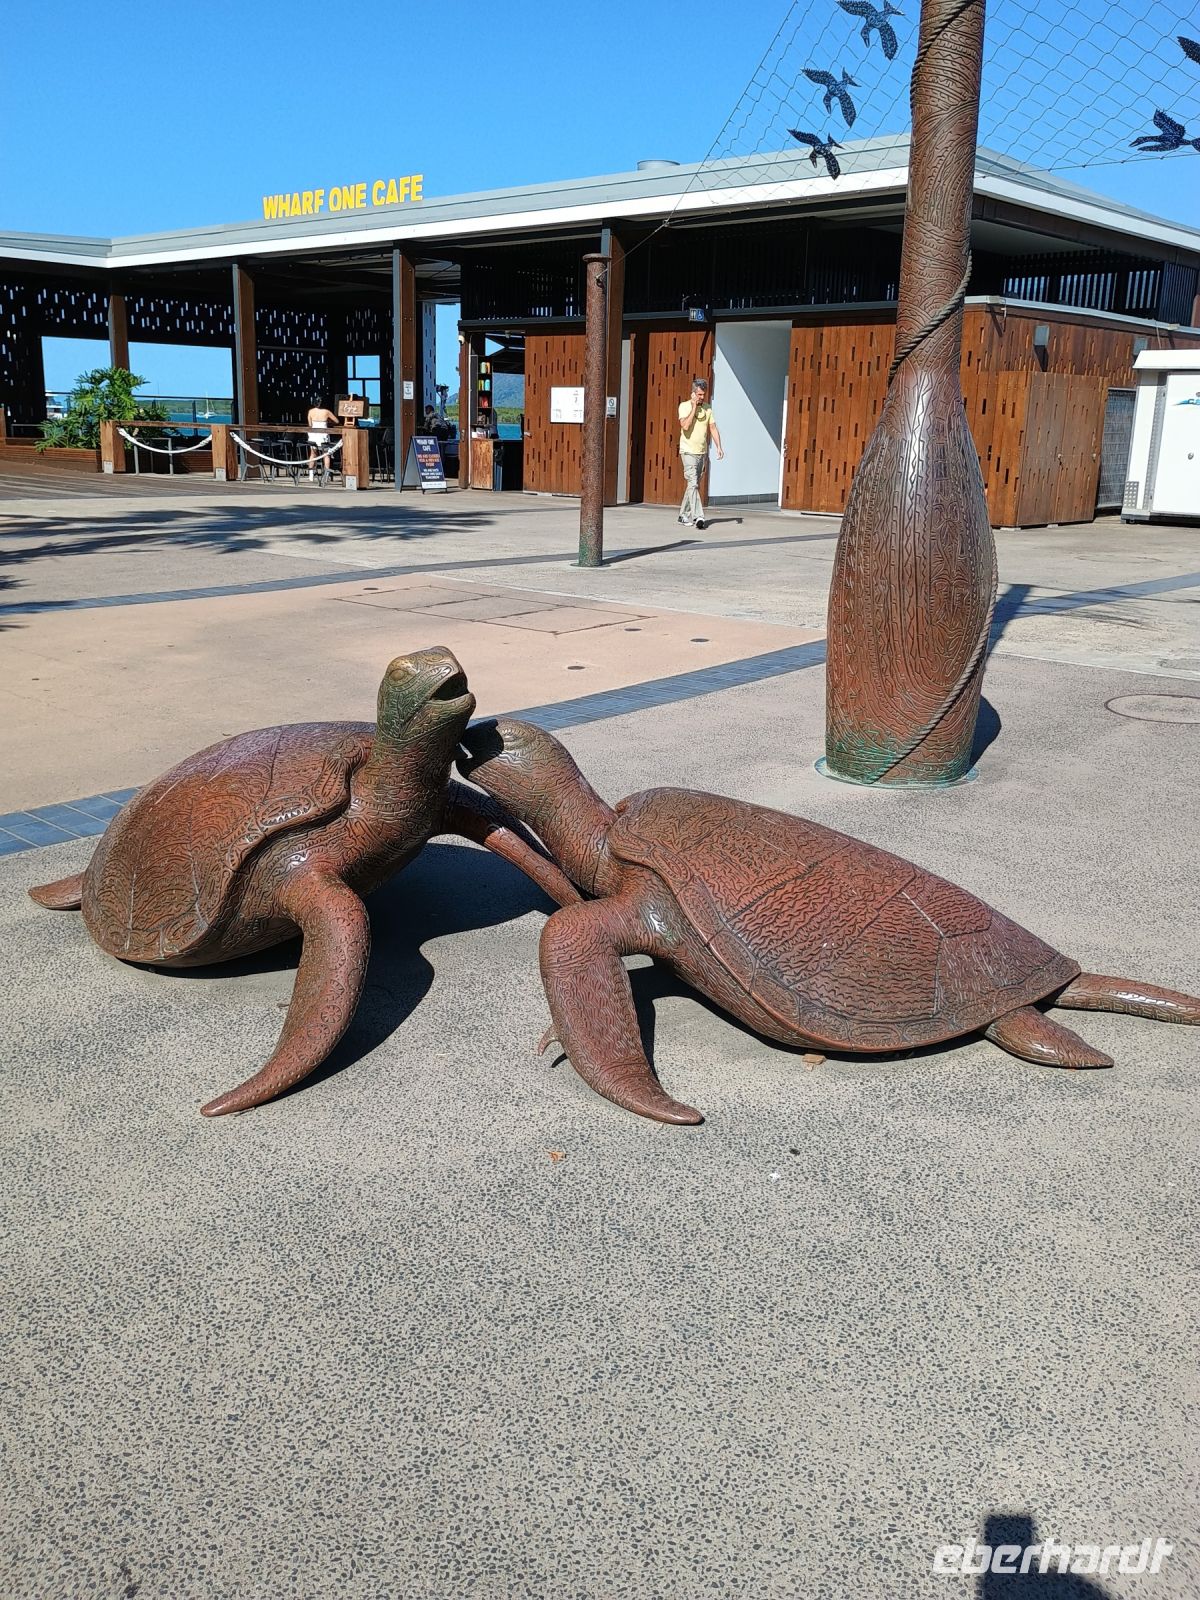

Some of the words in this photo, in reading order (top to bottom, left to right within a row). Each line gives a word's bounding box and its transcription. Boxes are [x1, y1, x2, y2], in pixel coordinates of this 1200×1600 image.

[263, 189, 325, 220] WHARF
[328, 183, 367, 212] ONE
[372, 174, 424, 206] CAFE
